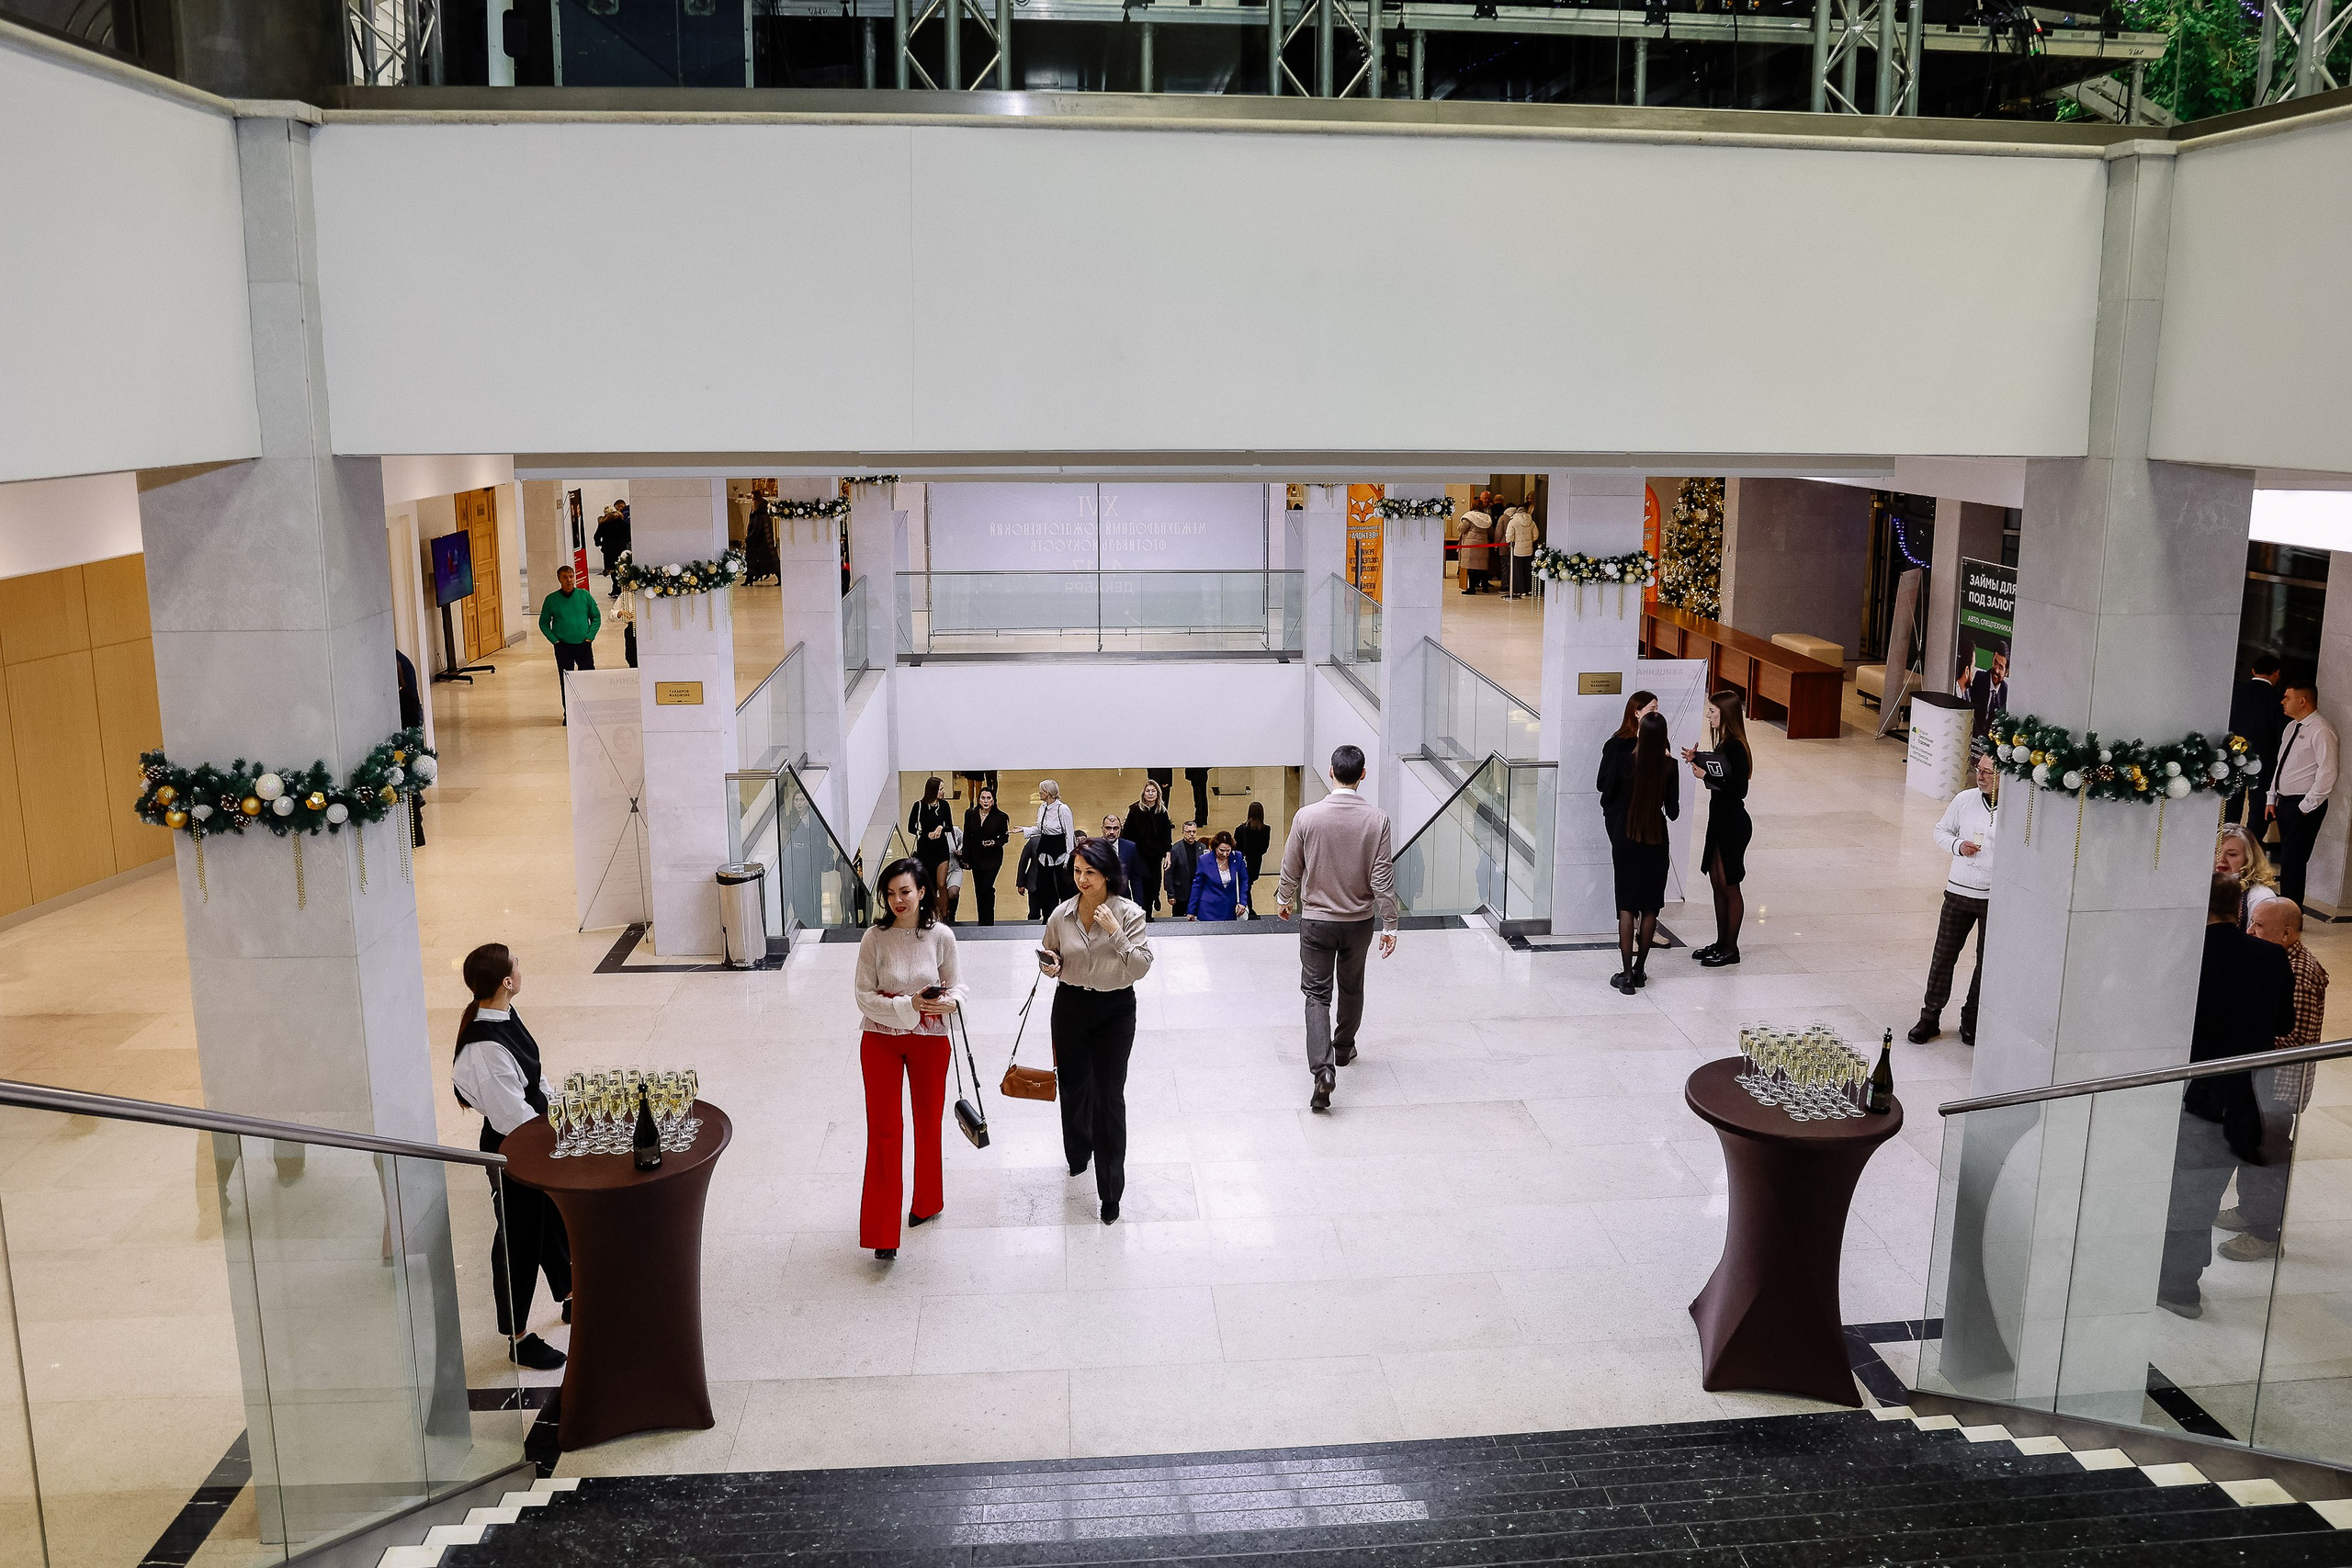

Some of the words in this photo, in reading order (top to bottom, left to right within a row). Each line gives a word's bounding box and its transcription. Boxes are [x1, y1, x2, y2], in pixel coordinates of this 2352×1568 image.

[1969, 573, 1999, 592] ЗАЙМЫ
[1999, 581, 2018, 595] ДЛЯ
[1968, 591, 1985, 607] ПОД
[1986, 595, 2015, 612] ЗАЛОГ
